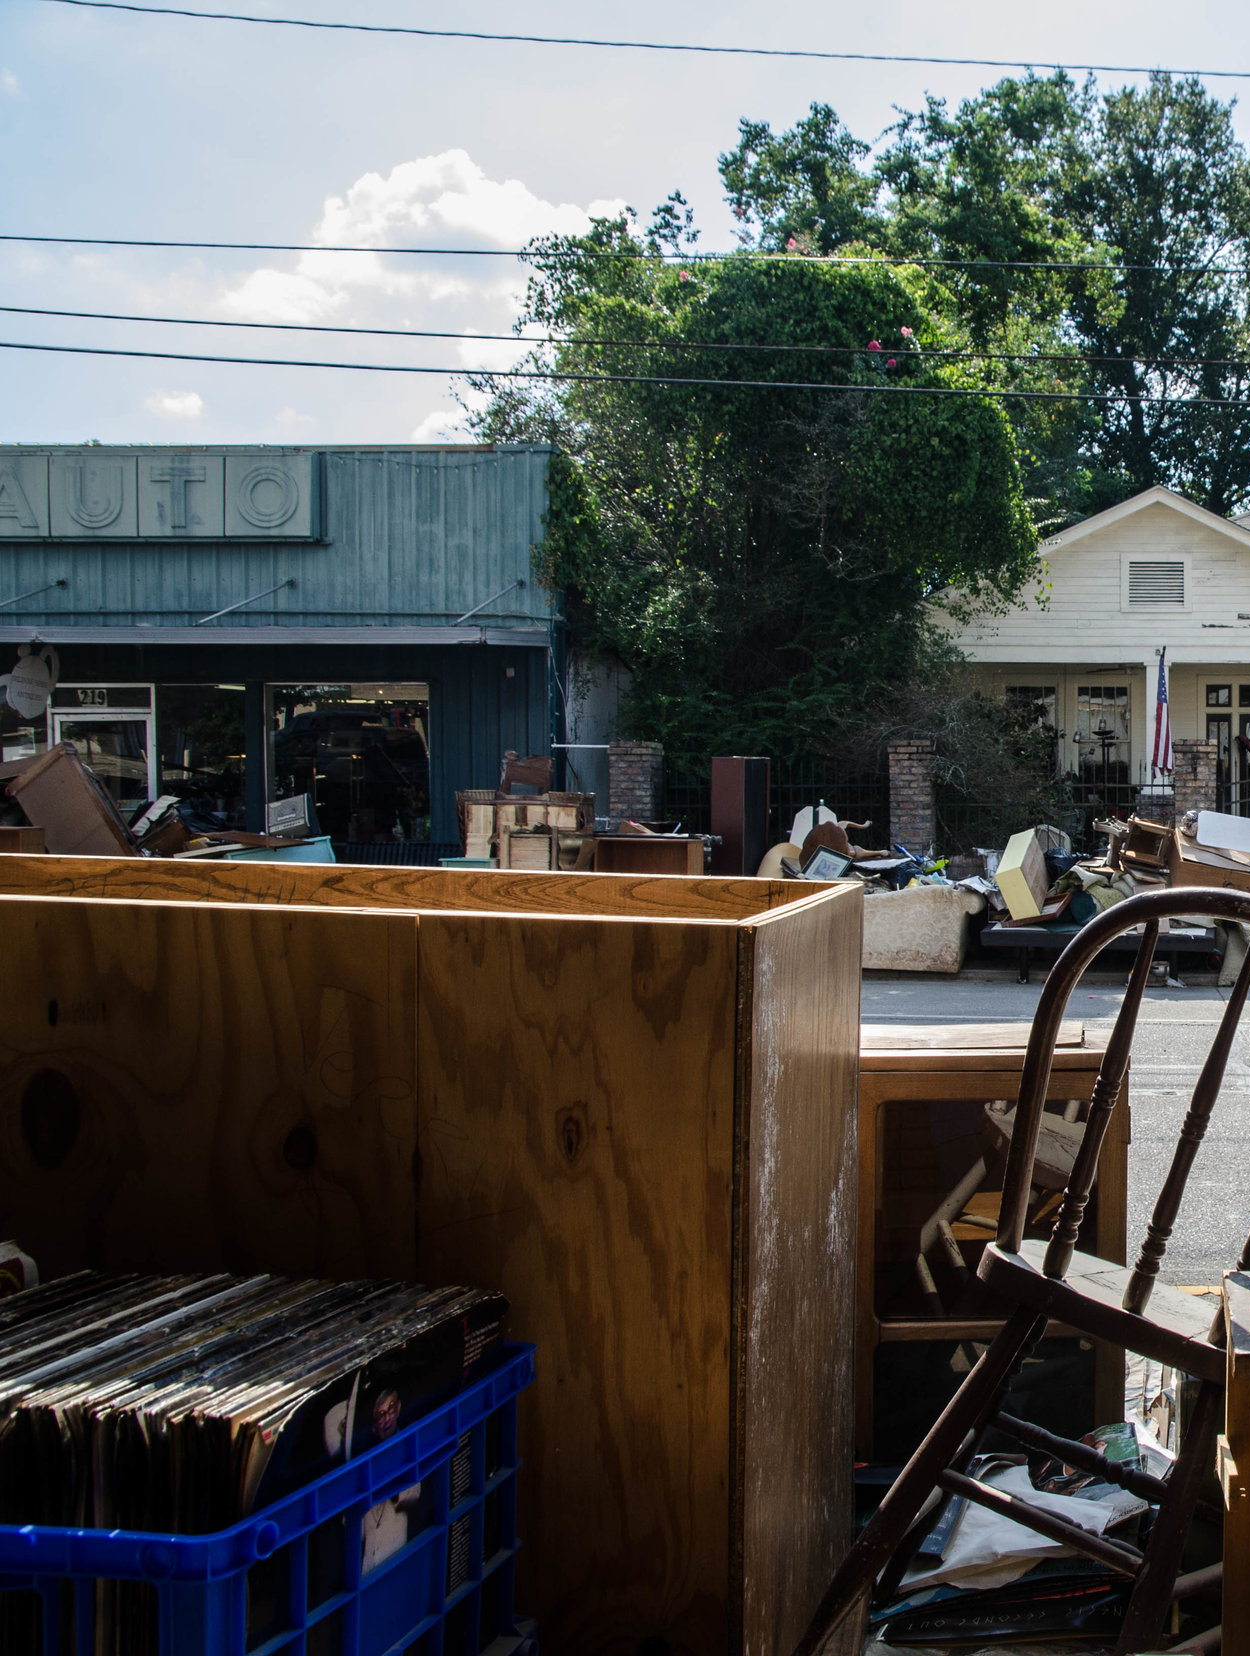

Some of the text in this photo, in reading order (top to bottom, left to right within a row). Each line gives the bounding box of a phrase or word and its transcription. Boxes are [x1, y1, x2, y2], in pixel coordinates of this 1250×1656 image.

[0, 465, 299, 529] AUTO
[80, 690, 106, 705] 219
[907, 1619, 946, 1631] OUT
[957, 1610, 1047, 1627] SECONDS
